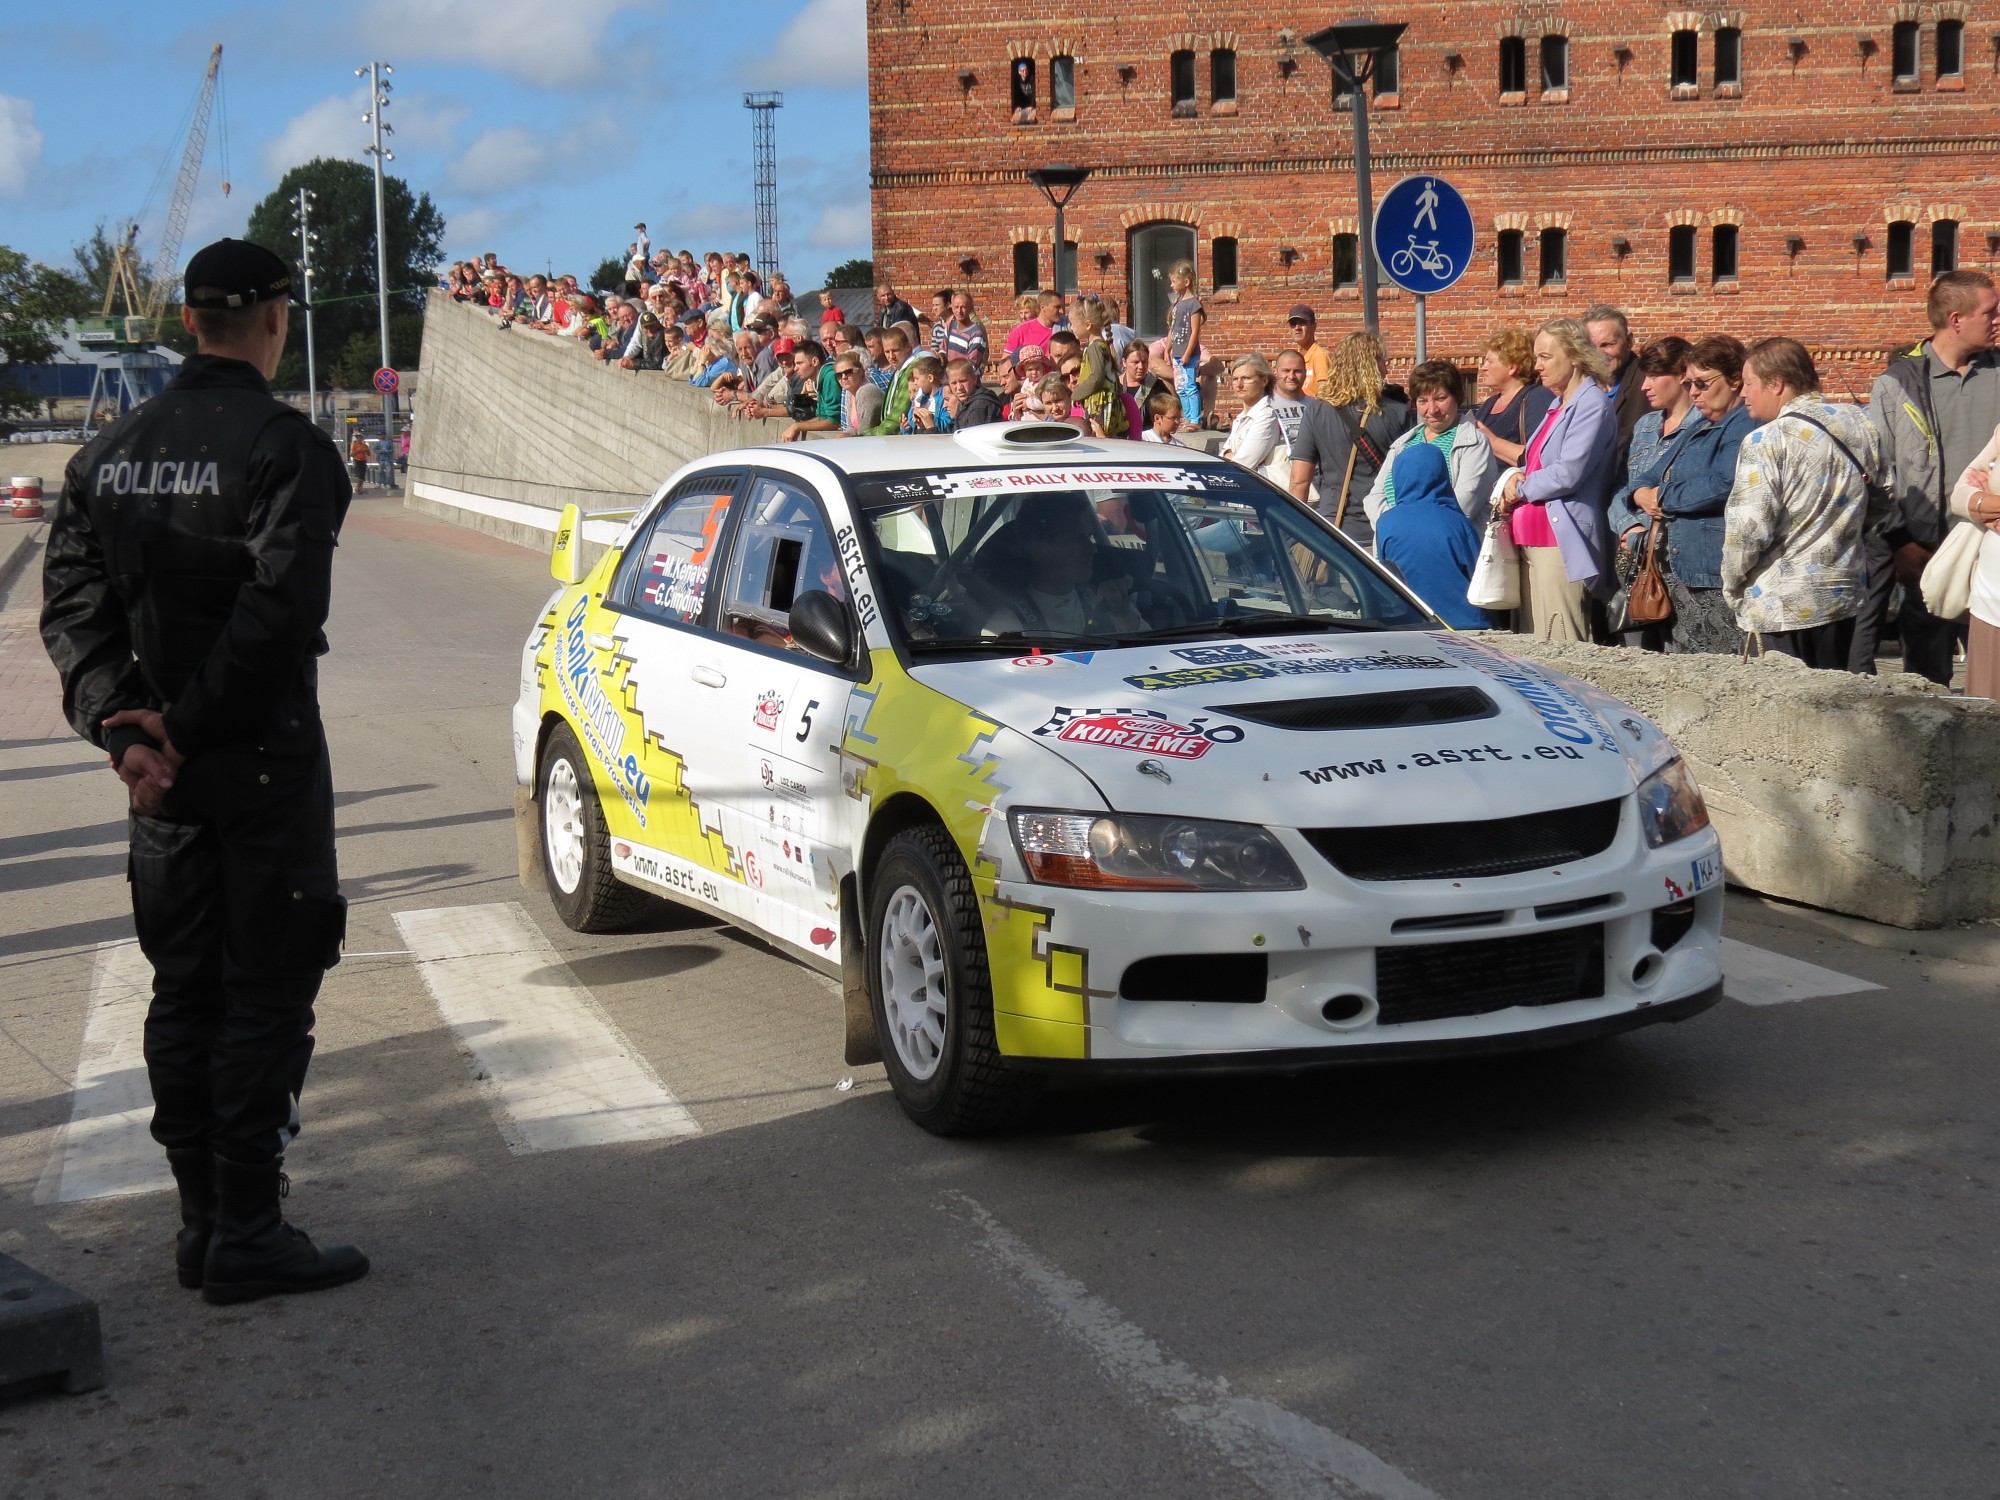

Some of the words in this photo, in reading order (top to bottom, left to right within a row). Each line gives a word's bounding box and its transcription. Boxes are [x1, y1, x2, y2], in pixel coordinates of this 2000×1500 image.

[96, 461, 220, 497] POLICIJA
[1007, 473, 1067, 486] RALLY
[1072, 473, 1171, 483] KURZEME
[690, 495, 734, 566] 5
[836, 525, 877, 632] asrt.eu
[1134, 665, 1264, 690] ASRT
[796, 699, 820, 743] 5
[1068, 723, 1204, 755] KURZEME
[1118, 719, 1175, 734] Rally
[1174, 717, 1246, 744] 50
[556, 666, 580, 717] Services
[583, 722, 604, 761] Grain
[604, 755, 647, 829] Processing
[1299, 743, 1585, 785] www.asrt.eu
[789, 780, 807, 794] CARGO
[633, 855, 719, 902] www.asrt.eu
